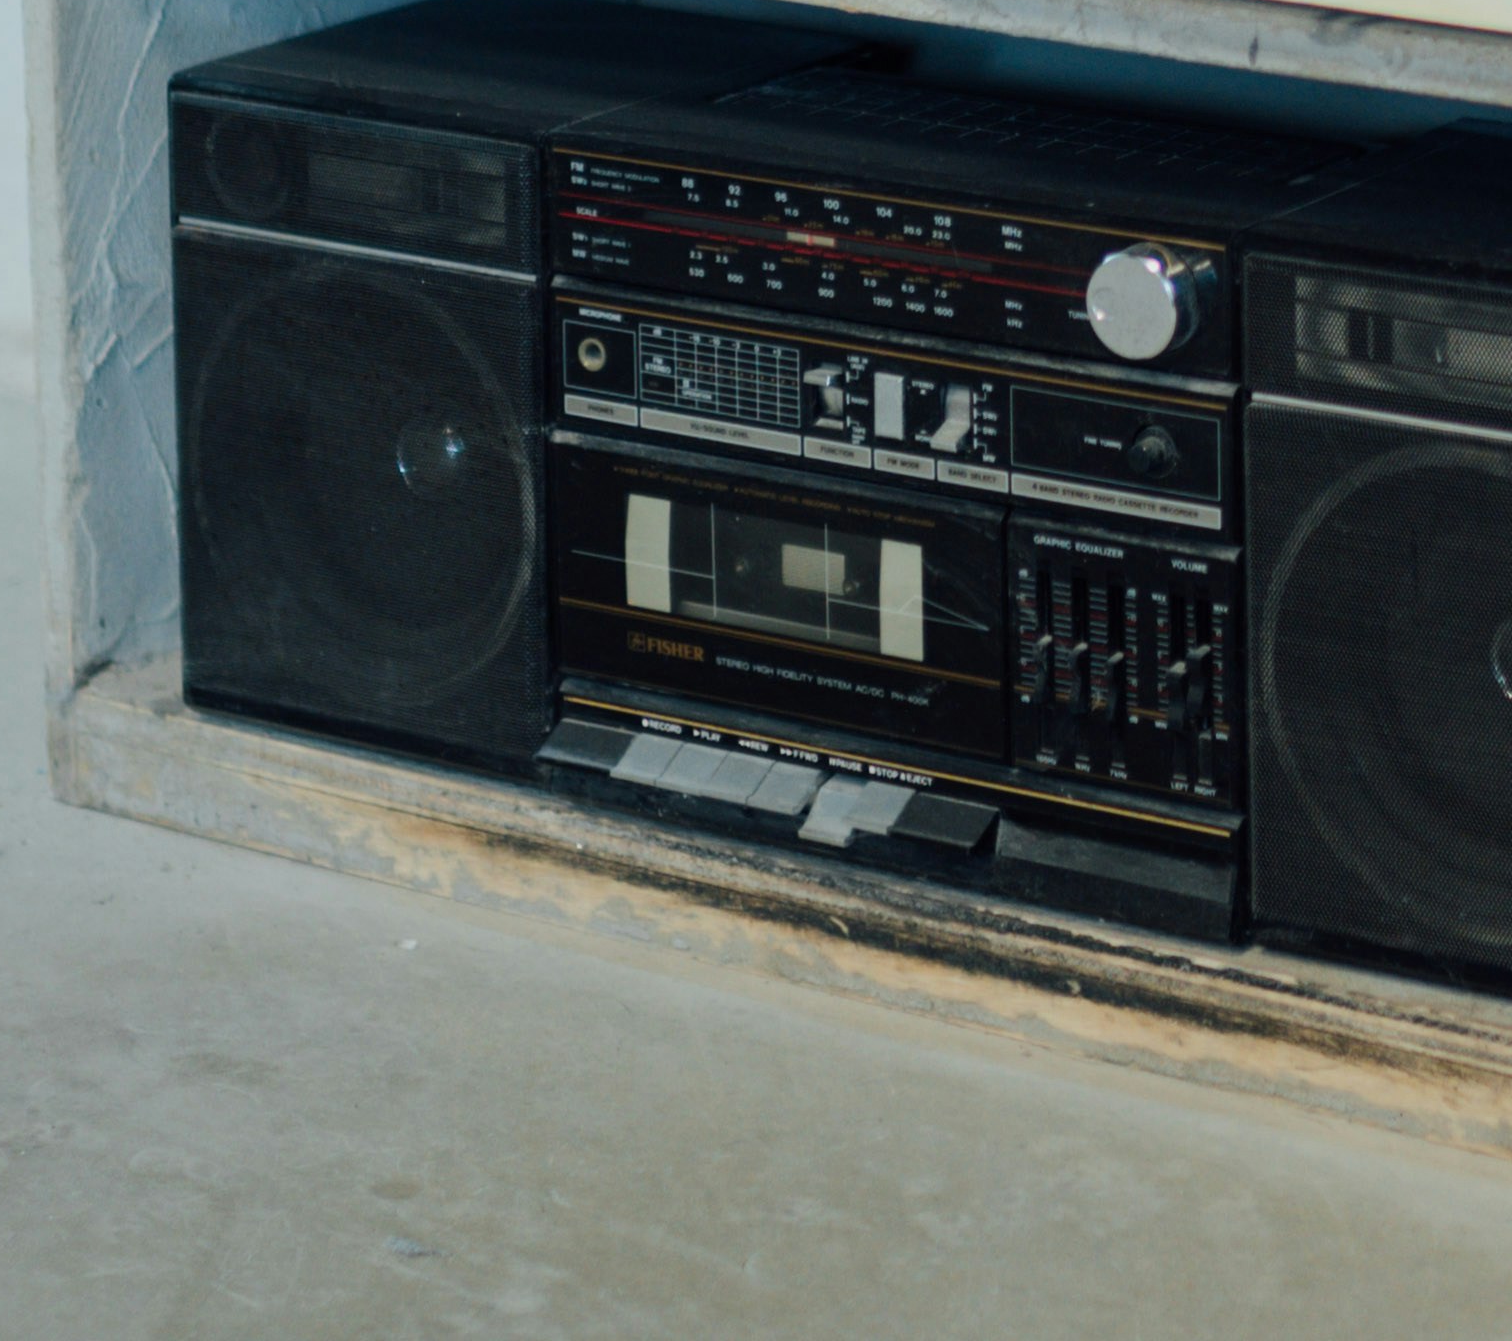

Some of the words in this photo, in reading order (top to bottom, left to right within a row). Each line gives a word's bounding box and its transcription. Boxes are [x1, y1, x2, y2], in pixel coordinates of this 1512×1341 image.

[570, 161, 585, 173] FM
[728, 184, 742, 196] 92
[823, 198, 841, 210] 100
[876, 206, 893, 219] 104
[934, 216, 953, 228] 108
[1001, 224, 1024, 239] MHz
[576, 205, 598, 218] SCALE
[903, 225, 923, 236] 20.0
[1004, 240, 1024, 252] MHz
[762, 262, 776, 273] 3.0
[821, 271, 835, 282] 4.0
[863, 277, 877, 288] 5.0
[934, 288, 948, 300] 7.0
[1004, 298, 1023, 312] MHz
[766, 279, 784, 292] 700
[818, 287, 835, 299] 900
[872, 295, 894, 308] 1200
[905, 301, 927, 314] 1400
[933, 305, 955, 318] 1600
[1006, 316, 1024, 330] kHz
[911, 379, 936, 391] STEREO
[820, 446, 856, 459] FUNCTION
[970, 472, 998, 484] SELECT
[1062, 488, 1092, 501] STEREO
[1093, 493, 1117, 506] RADIO
[1118, 497, 1157, 513] CASSETTE
[1159, 504, 1200, 520] RECORDER
[1033, 532, 1072, 552] GRAPHIC
[1074, 541, 1125, 559] EQUALIZER
[1170, 558, 1209, 575] VOLUME
[646, 635, 705, 664] FISHER
[715, 655, 751, 673] STEREO
[752, 660, 775, 677] HIGH
[776, 667, 815, 685] FIDELITY
[816, 674, 853, 693] SYSTEM
[855, 683, 886, 700] AC/DC
[649, 719, 683, 736] RECORD
[700, 727, 722, 743] PLAY
[837, 758, 863, 773] PAUSE
[876, 766, 899, 781] STOP
[906, 773, 934, 788] EJECT
[1170, 781, 1189, 793] LEFT
[1193, 785, 1218, 798] RIGHT
